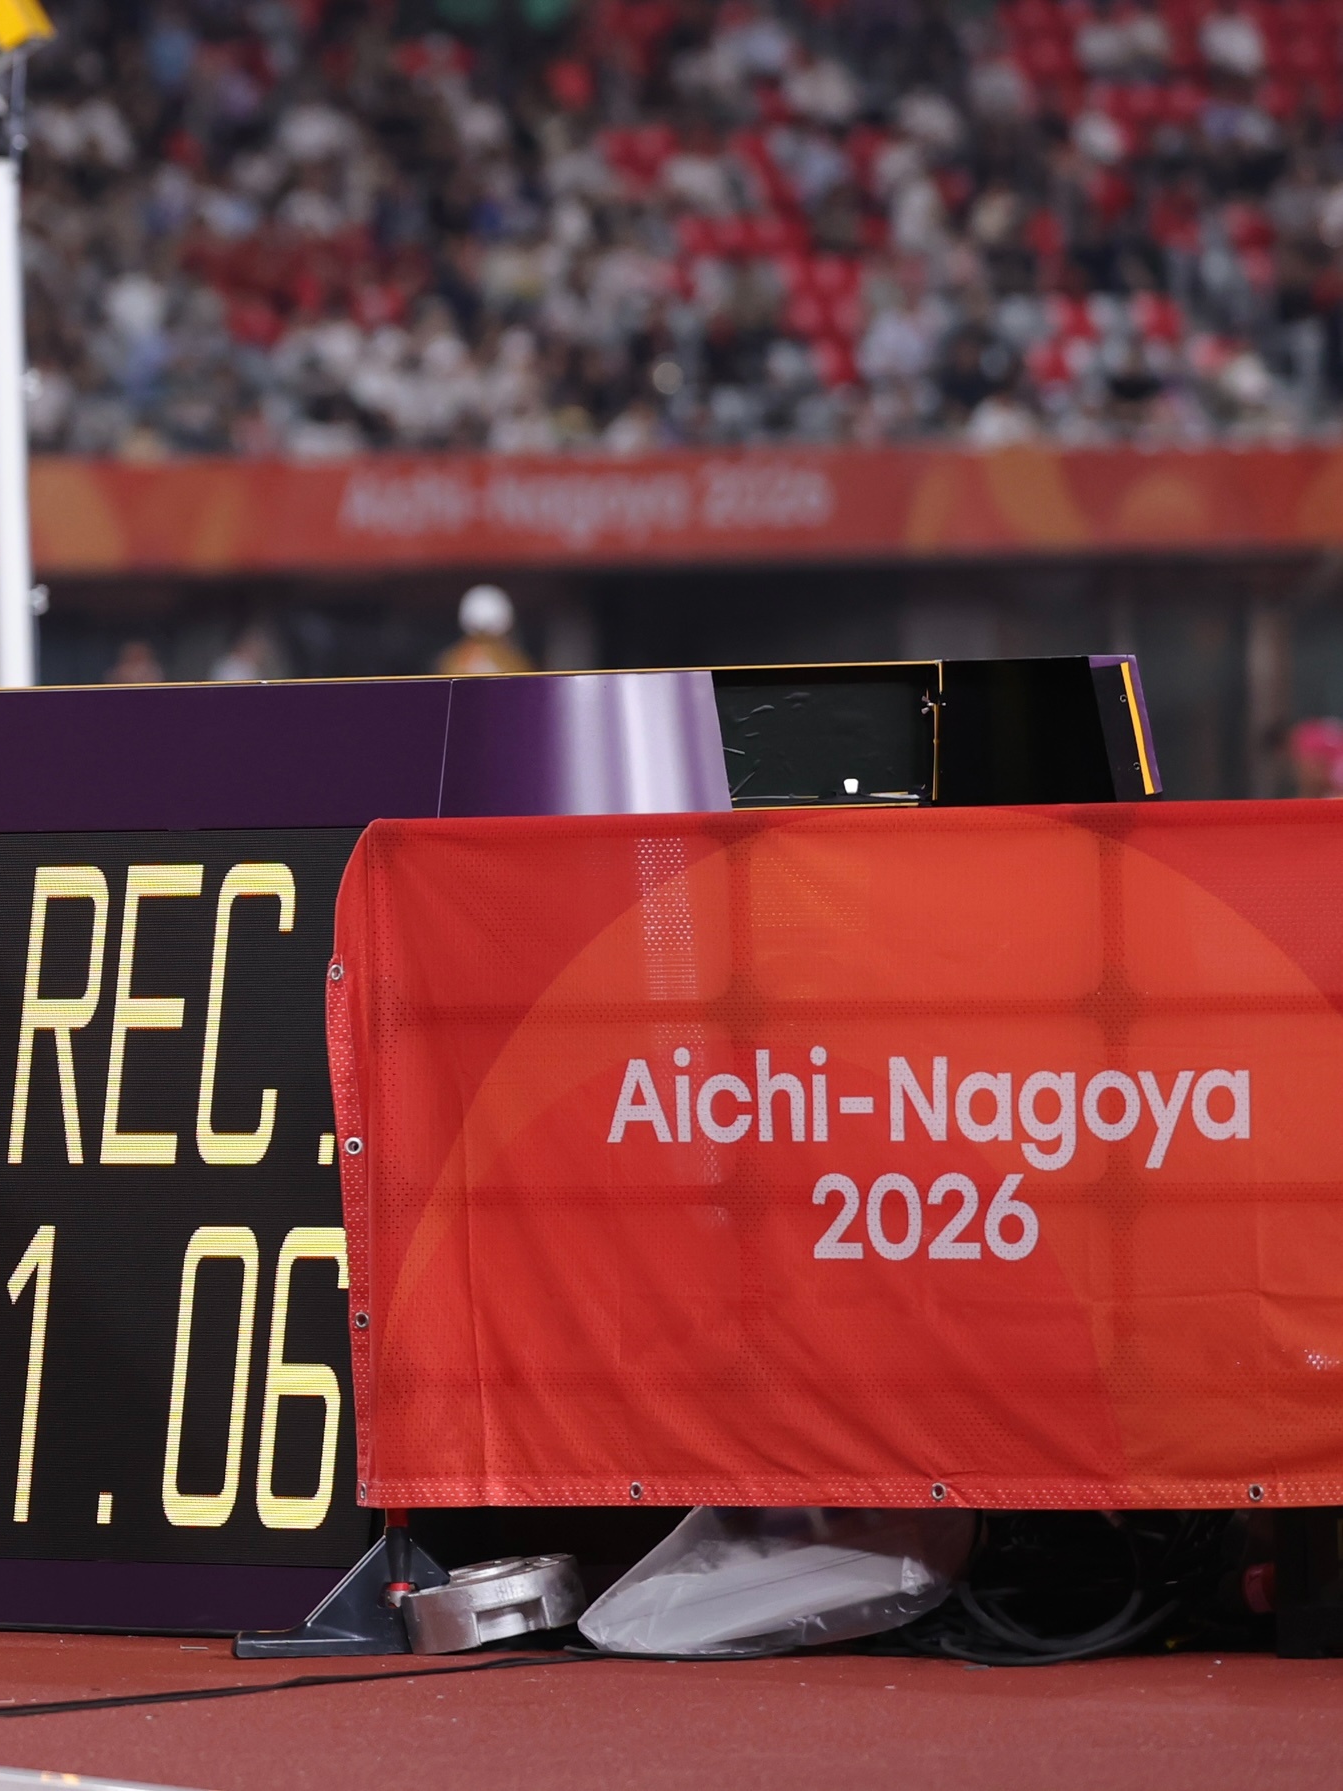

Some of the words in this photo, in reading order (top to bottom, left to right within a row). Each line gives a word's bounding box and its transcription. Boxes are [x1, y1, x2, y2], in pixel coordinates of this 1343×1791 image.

[7, 862, 335, 1166] REC.
[607, 1045, 1251, 1171] Aichi-Nagoya
[812, 1172, 1040, 1262] 2026
